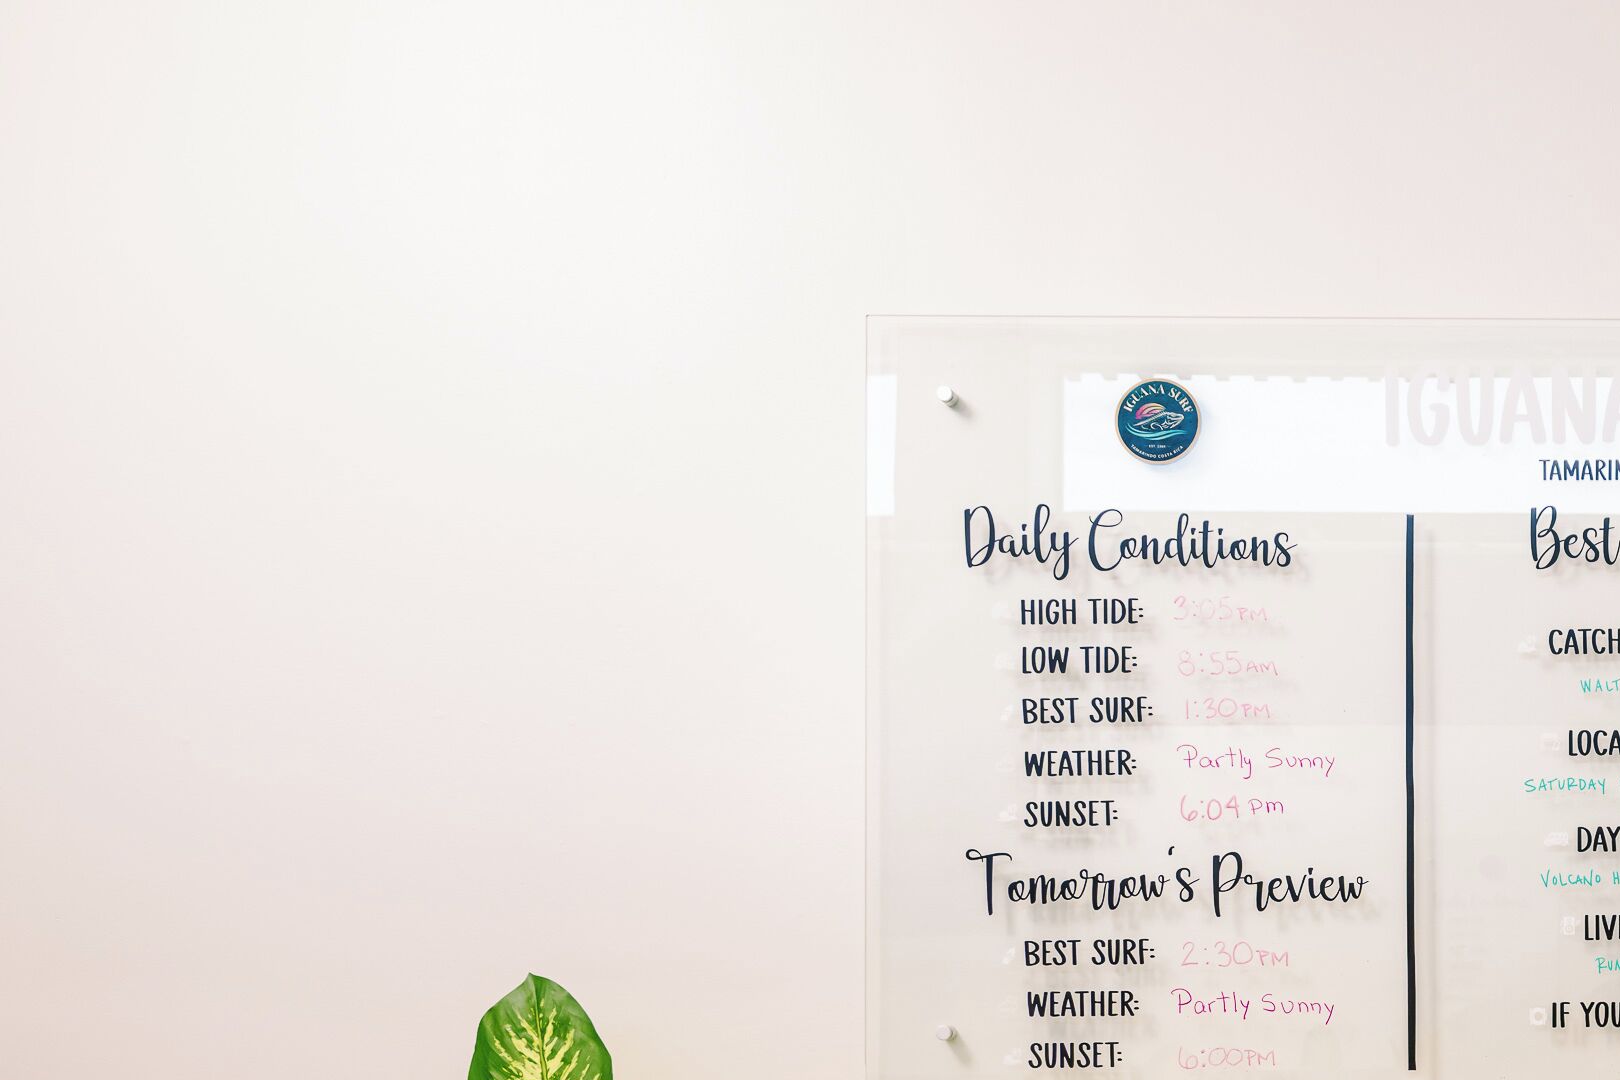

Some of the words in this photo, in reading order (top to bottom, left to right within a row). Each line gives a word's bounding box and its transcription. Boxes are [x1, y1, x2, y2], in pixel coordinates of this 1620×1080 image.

[1123, 384, 1165, 412] IGUANA
[1168, 387, 1193, 412] SURF
[964, 503, 1079, 581] Daily
[1088, 508, 1297, 572] Conditions
[1020, 598, 1077, 625] HIGH
[1087, 598, 1144, 625] TIDE:
[1022, 646, 1070, 674] LOW
[1079, 646, 1138, 674] TIDE:
[1022, 697, 1079, 725] BEST
[1089, 696, 1154, 724] SURF:
[1024, 749, 1137, 777] WEATHER:
[1176, 744, 1252, 780] Partly
[1265, 747, 1335, 777] Sunny
[1524, 777, 1607, 795] SATURDAY
[1023, 800, 1119, 828] SUNSET:
[1180, 795, 1240, 821] 6:04
[965, 845, 1200, 916] Tomorrow's
[1212, 851, 1369, 918] Preview
[1541, 869, 1601, 887] VOLCANO
[1024, 939, 1082, 967] BEST
[1091, 938, 1156, 966] SURF:
[1027, 990, 1140, 1018] WEATHER:
[1170, 988, 1250, 1020] Partly
[1261, 993, 1335, 1025] Sunny
[1551, 1001, 1571, 1029] IF
[1028, 1041, 1123, 1069] SUNSET:
